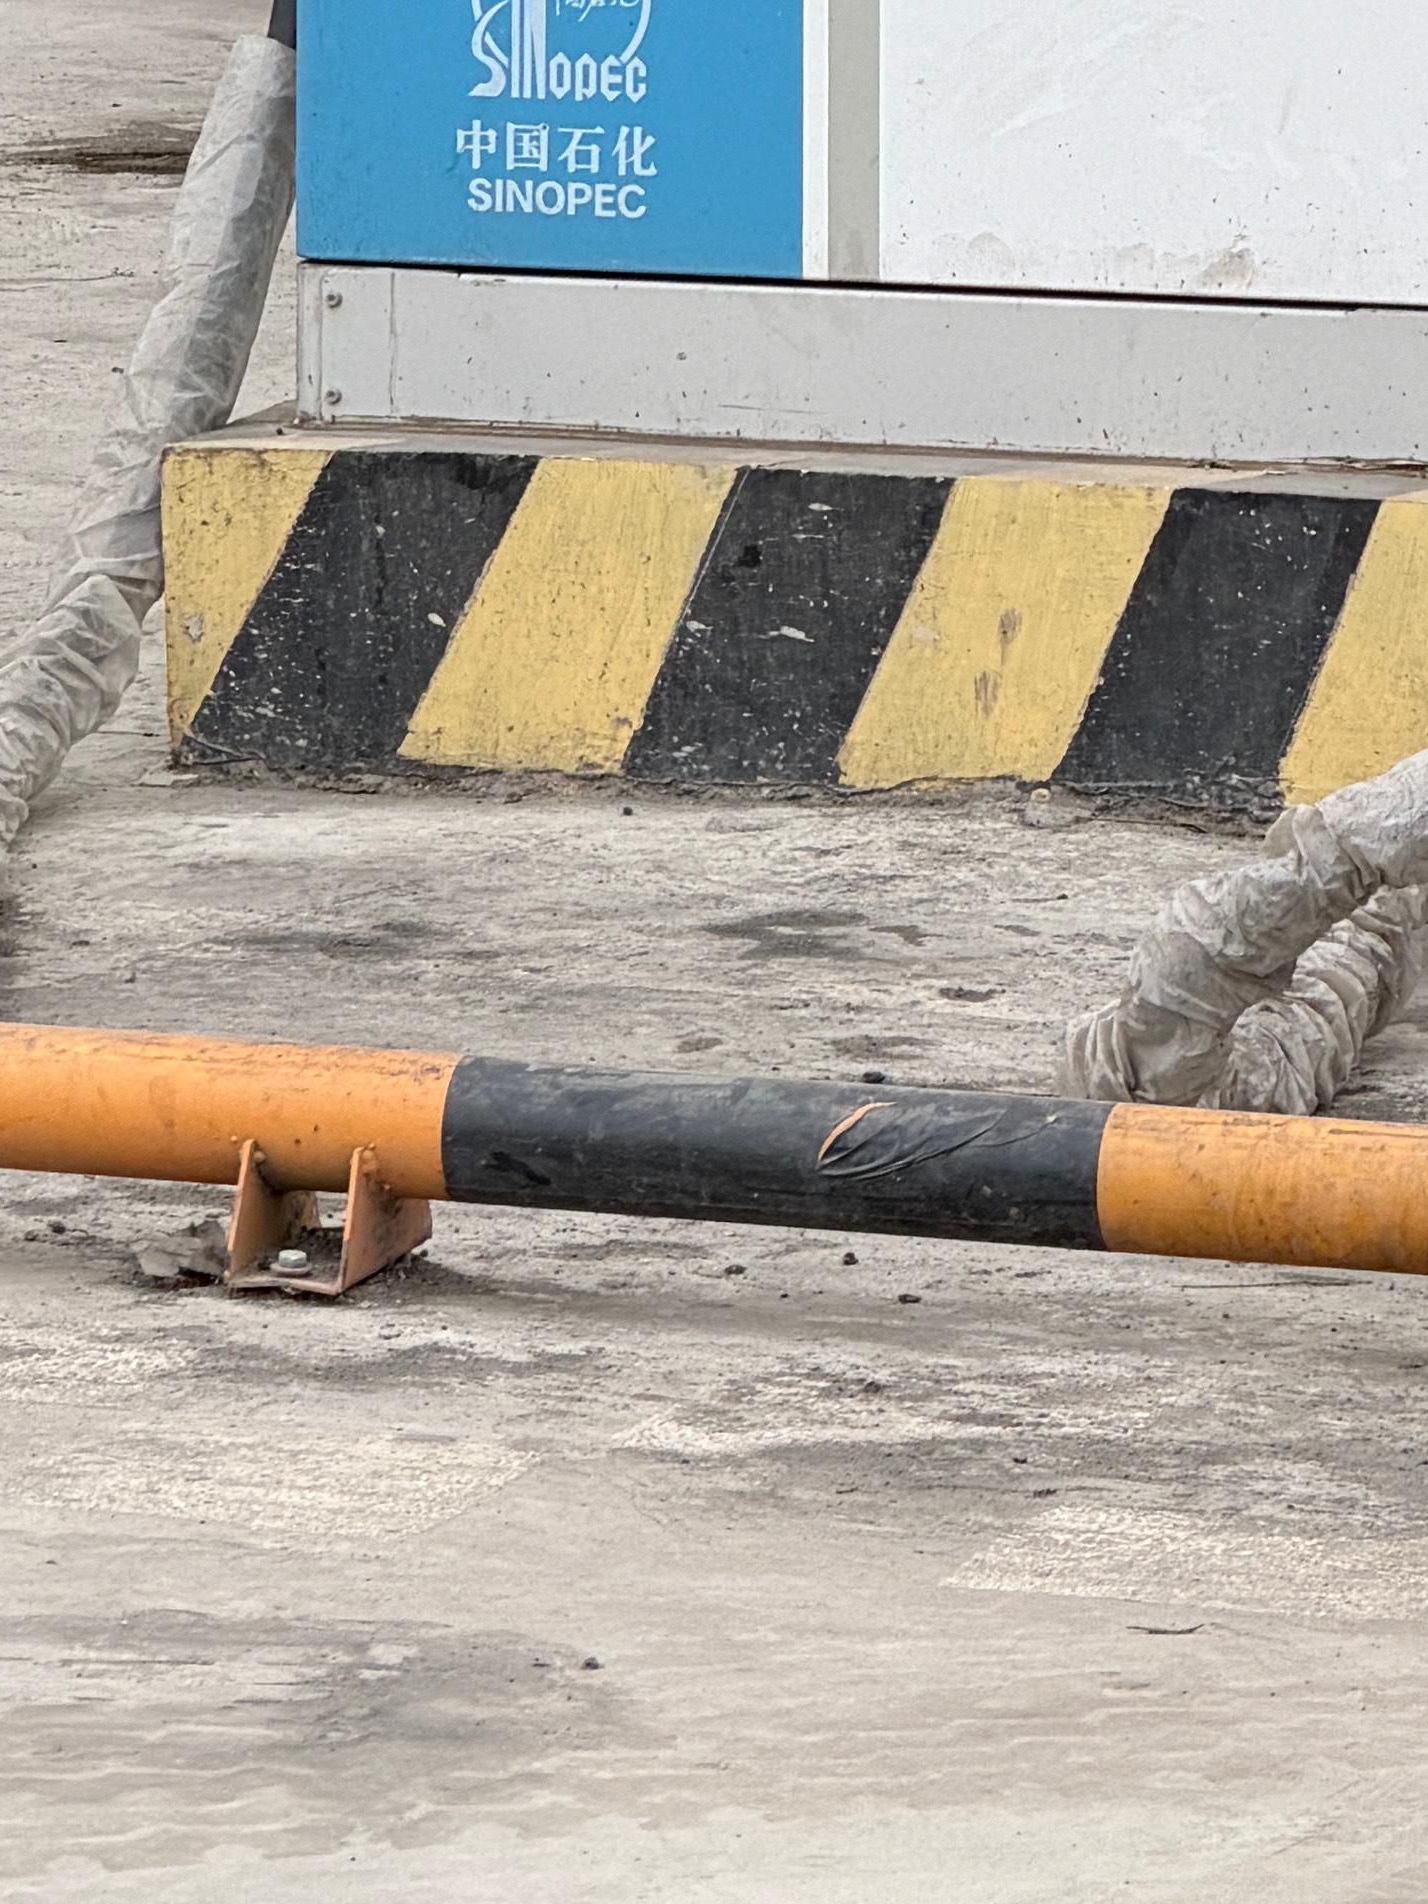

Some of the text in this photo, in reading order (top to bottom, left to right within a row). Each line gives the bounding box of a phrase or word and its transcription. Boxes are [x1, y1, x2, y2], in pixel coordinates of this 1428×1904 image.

[456, 119, 658, 176] 中国石化
[467, 177, 648, 219] SINOPEC
